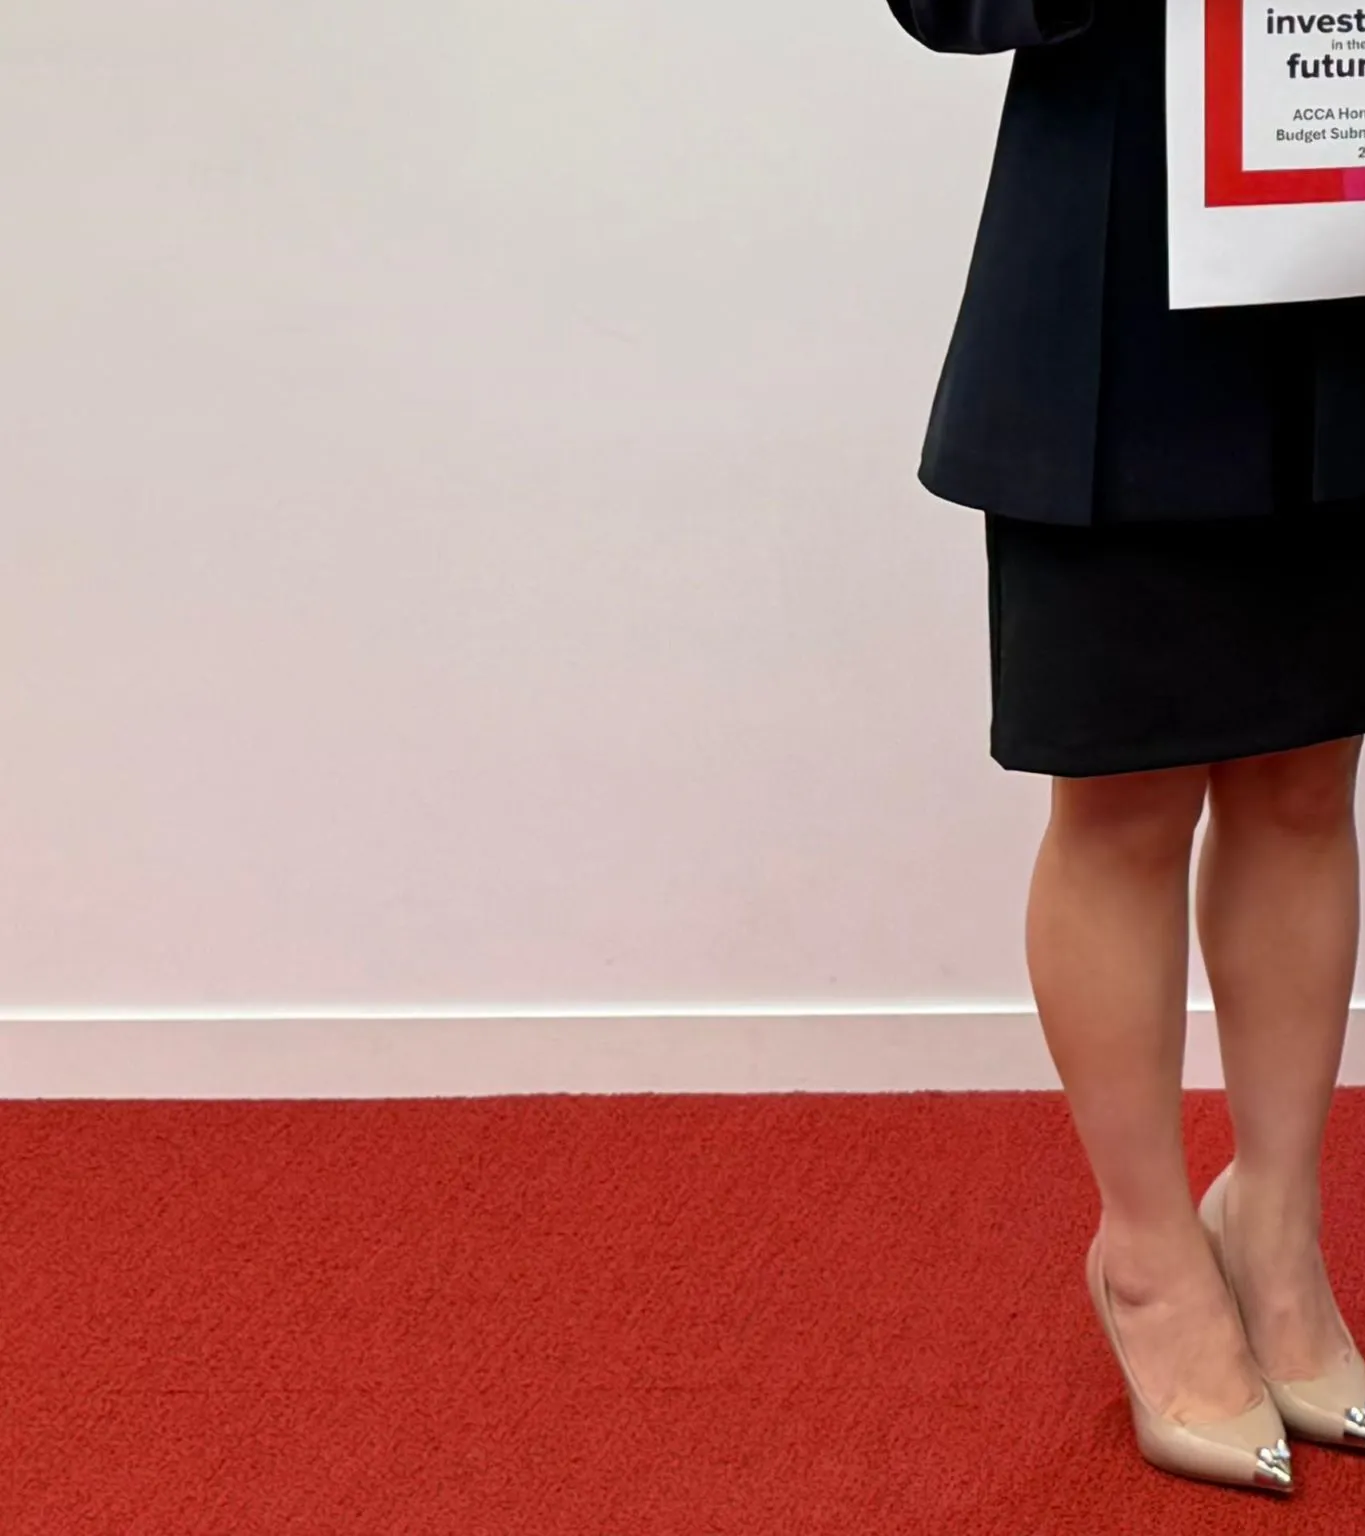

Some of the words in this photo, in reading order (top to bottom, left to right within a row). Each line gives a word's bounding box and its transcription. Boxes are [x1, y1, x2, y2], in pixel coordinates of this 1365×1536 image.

[1331, 40, 1344, 51] in
[1292, 108, 1336, 122] ACCA
[1275, 129, 1327, 144] Budget
